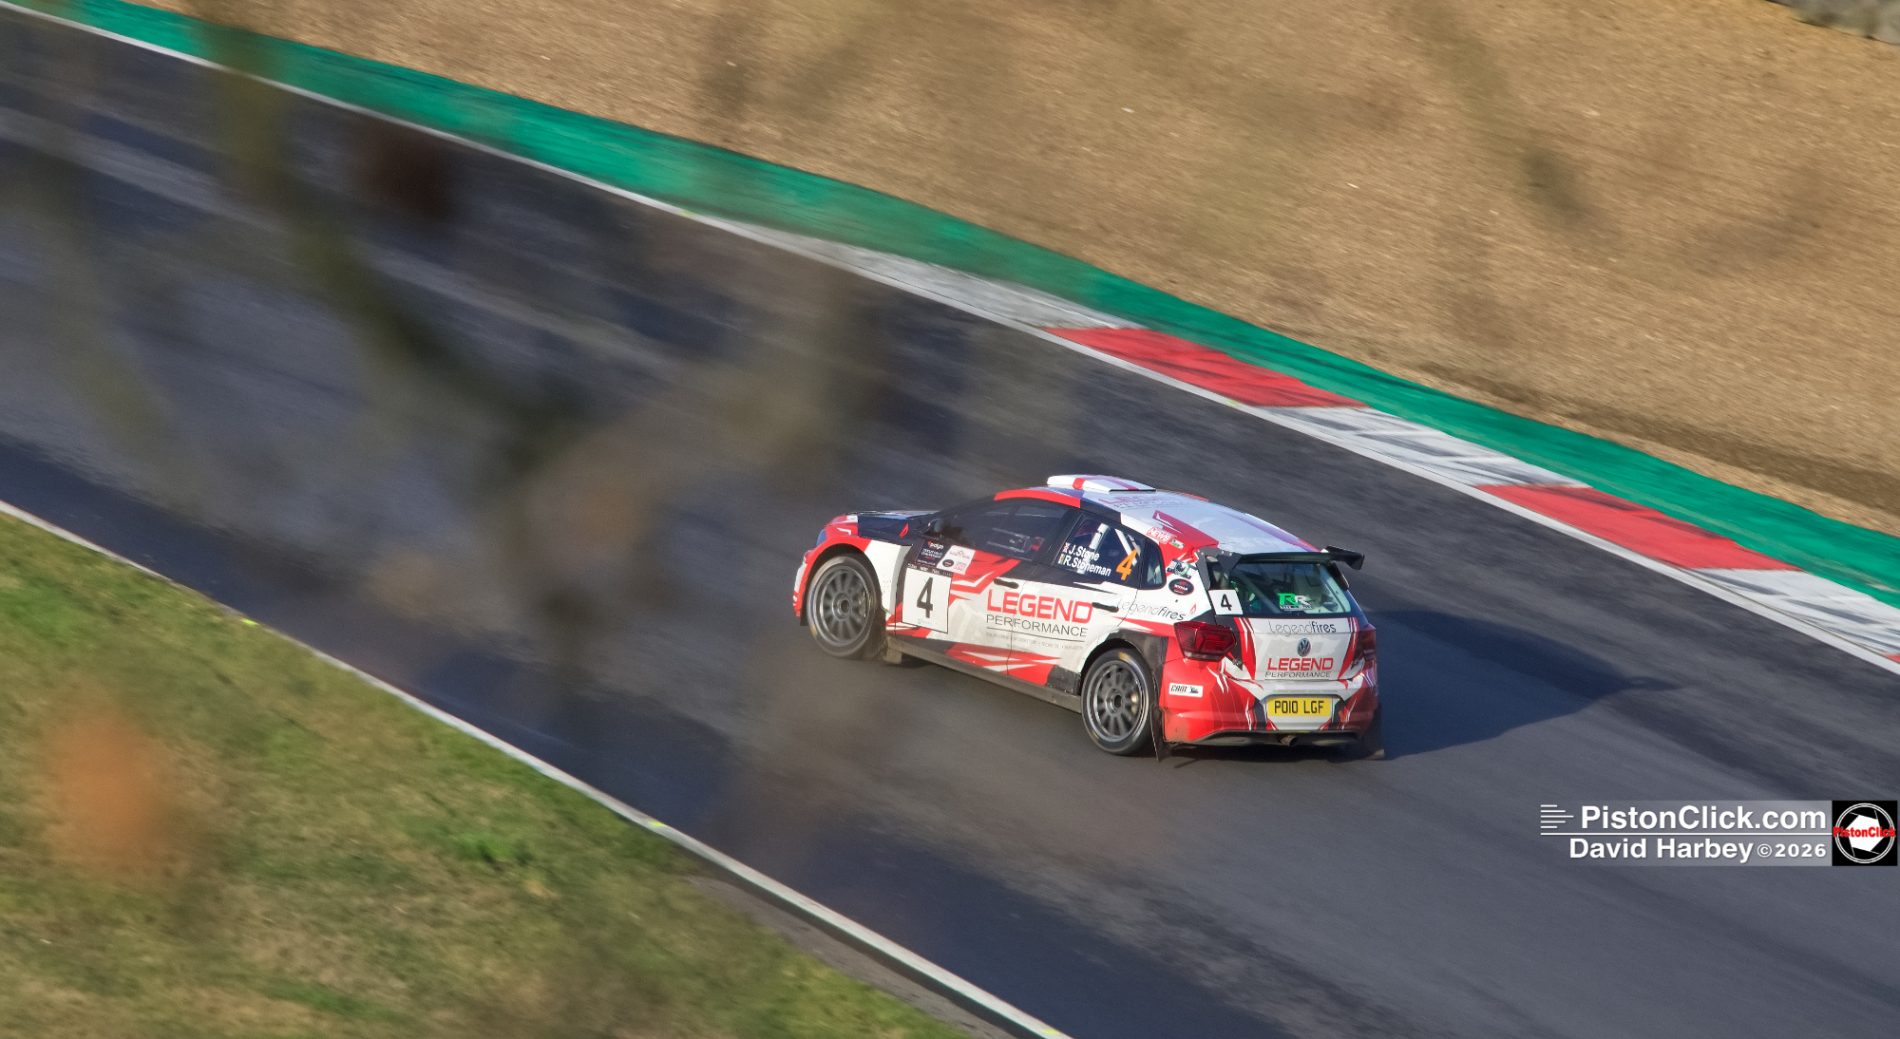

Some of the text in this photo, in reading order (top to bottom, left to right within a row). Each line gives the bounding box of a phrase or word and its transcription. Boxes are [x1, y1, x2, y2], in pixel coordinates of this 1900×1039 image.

[1069, 544, 1100, 561] J.Stone
[1063, 555, 1112, 577] R.Stoneman
[1115, 549, 1138, 581] 4
[916, 576, 934, 619] 4
[986, 588, 1094, 624] LEGEND
[1220, 593, 1232, 612] 4
[986, 614, 1089, 637] PERFORMANCE
[1267, 657, 1334, 671] LEGEND
[1275, 700, 1325, 714] PO10 LGF
